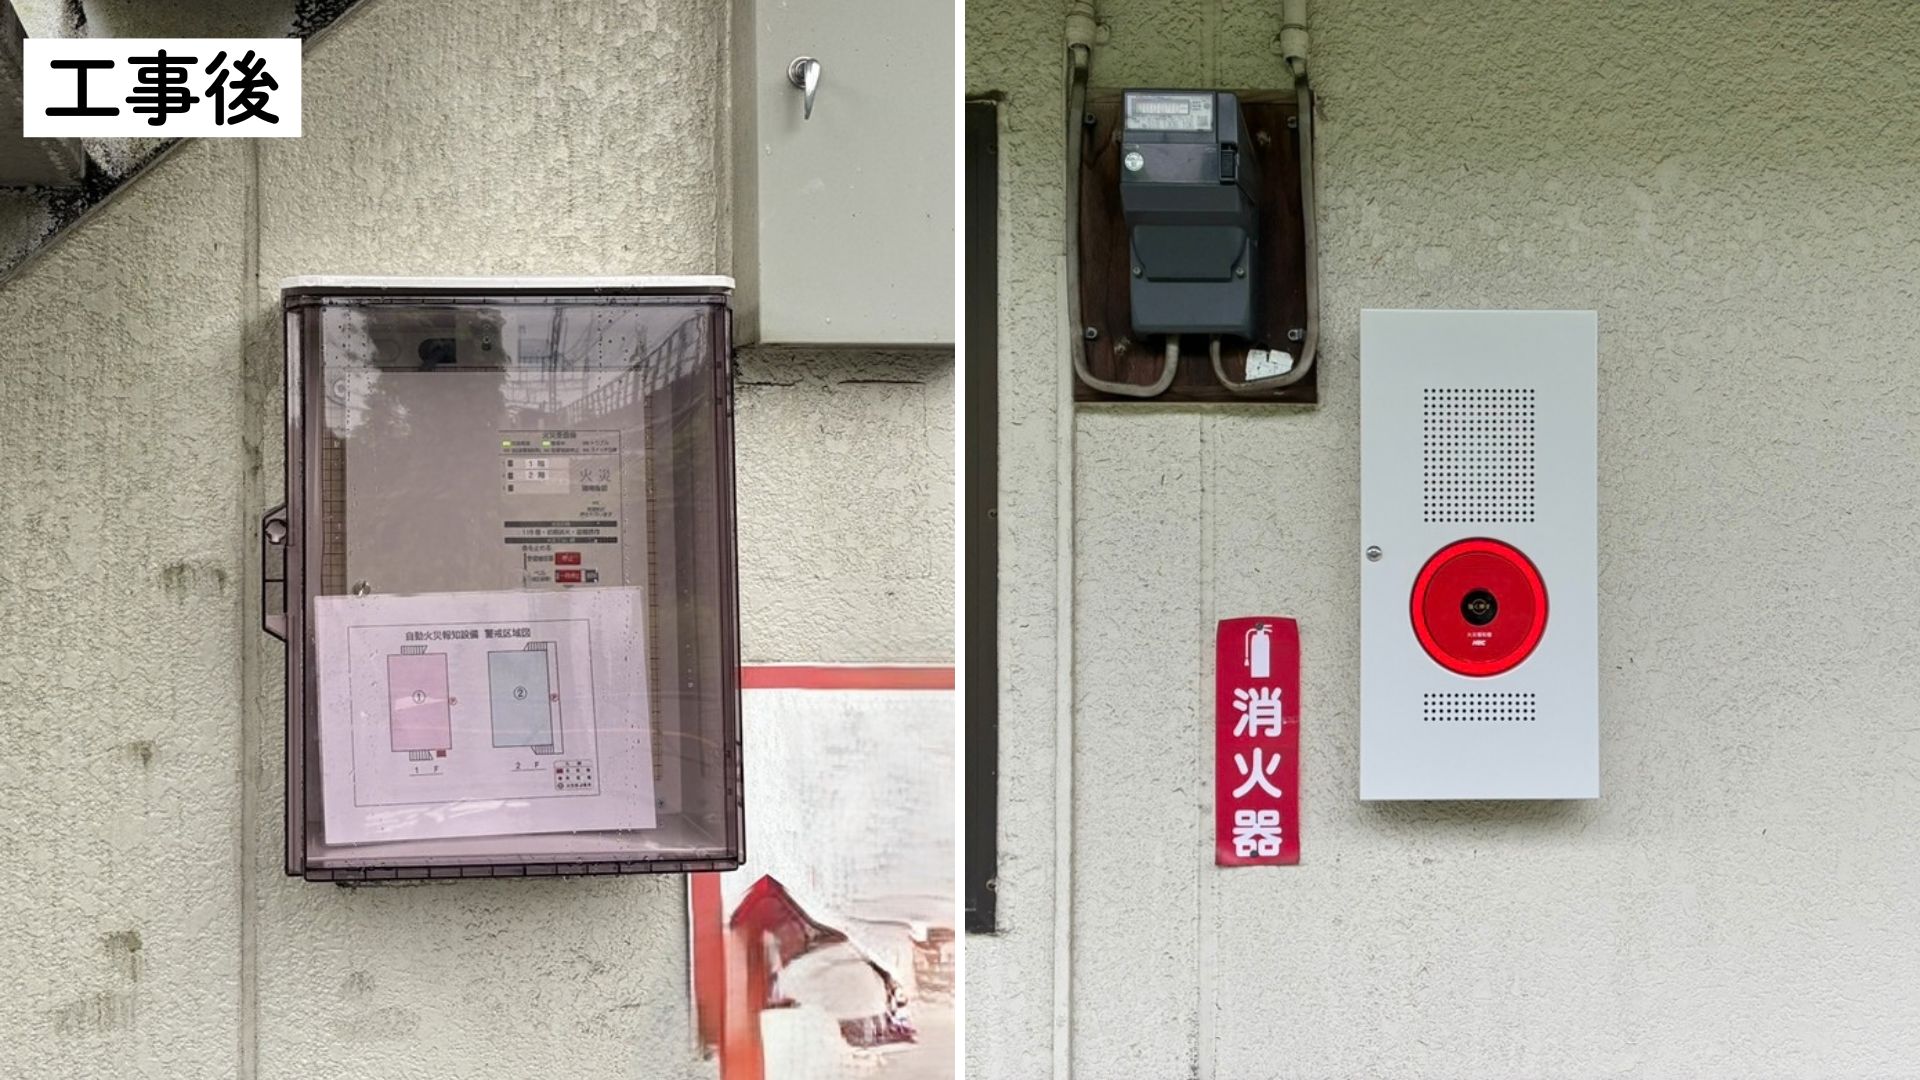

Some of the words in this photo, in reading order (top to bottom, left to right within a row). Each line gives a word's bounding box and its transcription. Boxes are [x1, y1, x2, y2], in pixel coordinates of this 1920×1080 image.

[405, 629, 479, 641] 自動火災報知設備
[484, 627, 532, 639] 警戒区域図
[1232, 686, 1283, 858] 消火器
